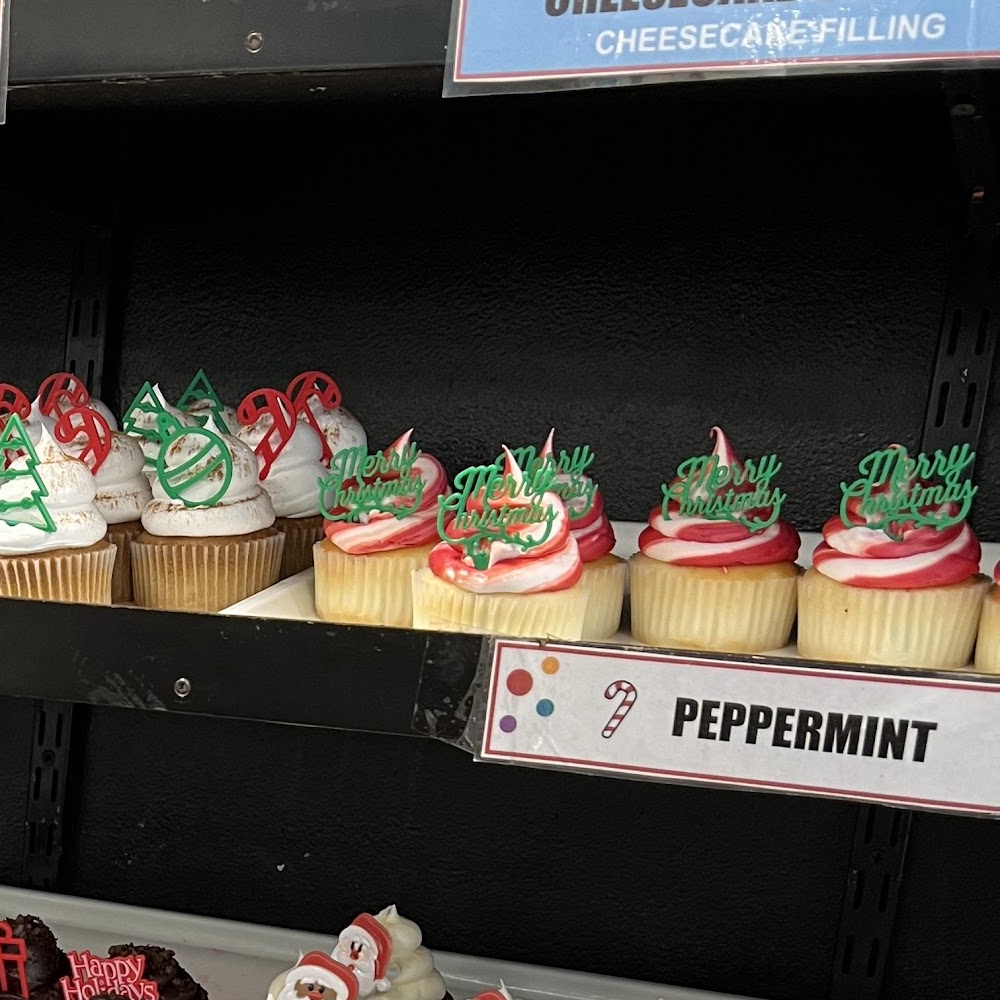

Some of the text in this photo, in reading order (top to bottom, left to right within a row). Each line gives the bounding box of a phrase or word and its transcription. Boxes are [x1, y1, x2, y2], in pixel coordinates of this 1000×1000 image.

[819, 13, 946, 43] FILLING
[330, 441, 421, 480] Merry
[677, 454, 782, 491] Merry
[859, 444, 976, 487] Merry
[454, 463, 553, 504] Merry
[672, 697, 937, 763] PEPPERMINT
[68, 951, 144, 986] Happy
